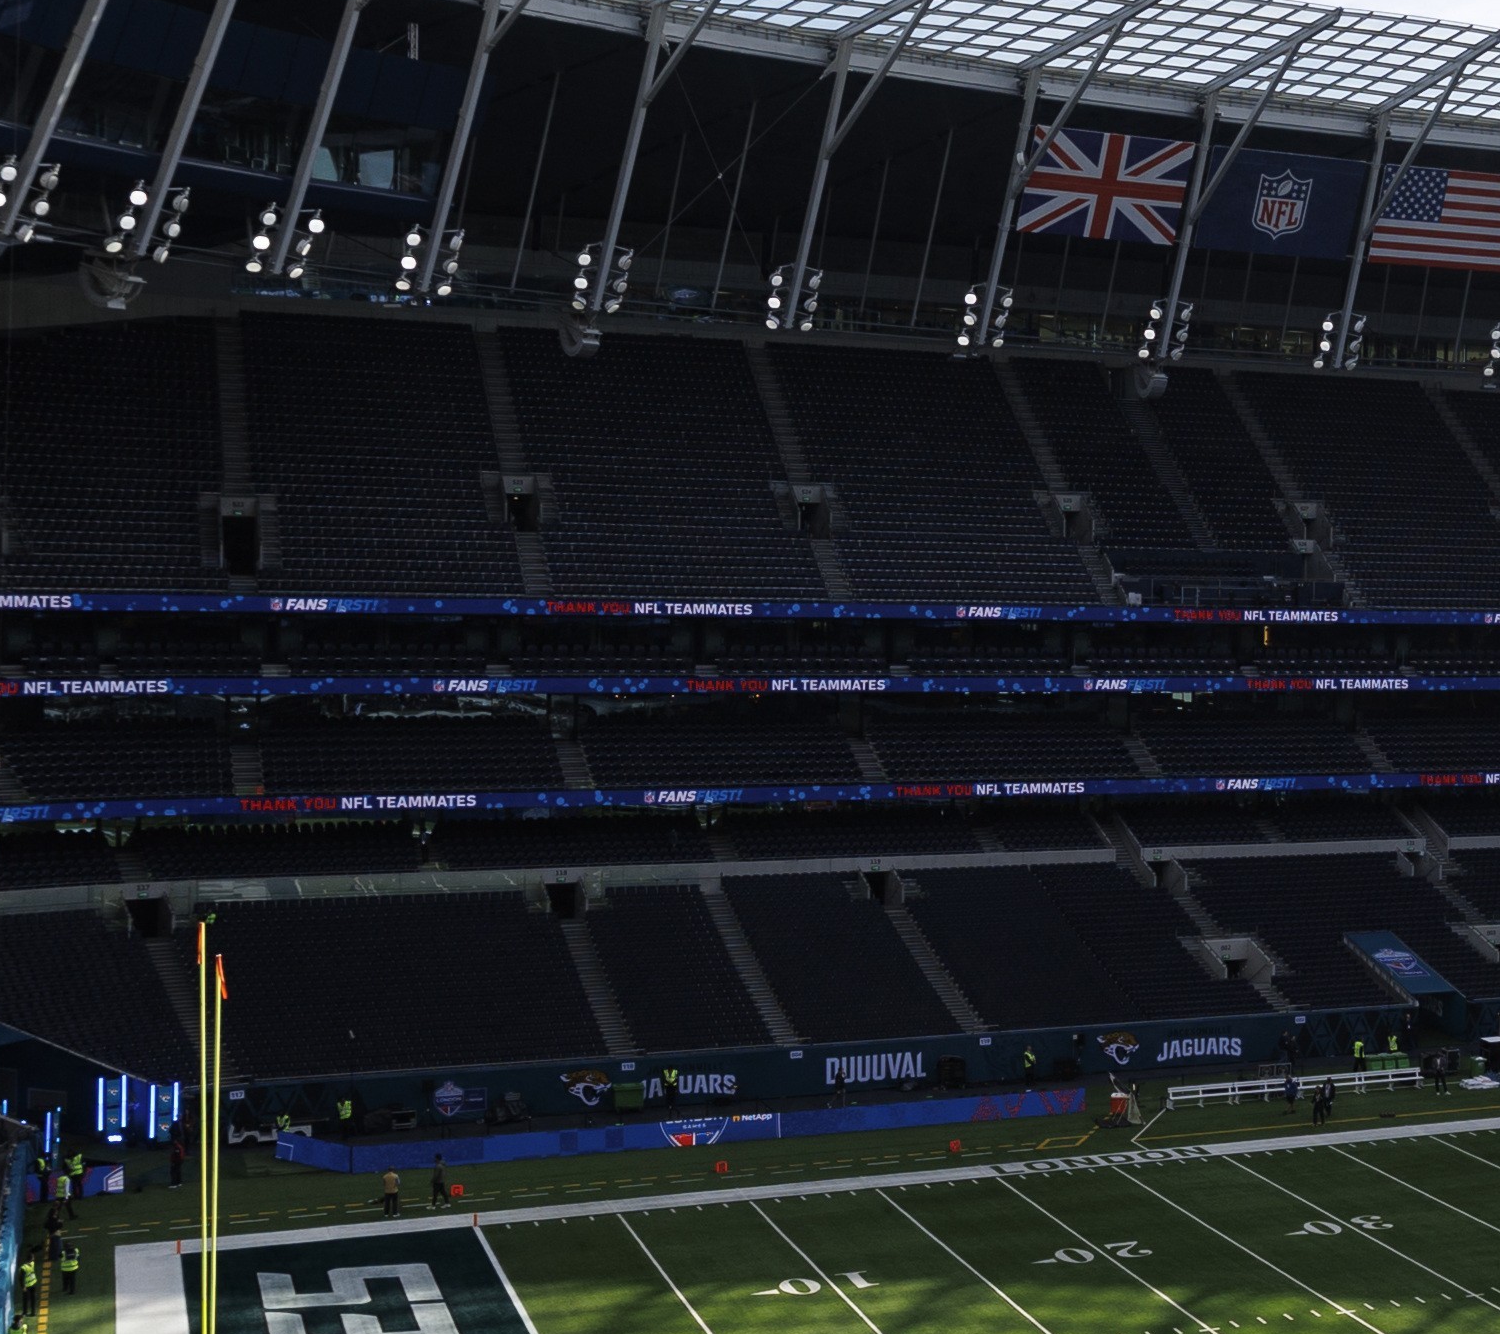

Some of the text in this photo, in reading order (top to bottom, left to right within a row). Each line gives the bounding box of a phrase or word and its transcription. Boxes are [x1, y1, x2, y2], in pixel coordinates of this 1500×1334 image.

[1258, 197, 1300, 230] NFL
[635, 602, 661, 615] NFL
[665, 602, 753, 616] TEAMMATES
[1268, 610, 1339, 622] TEAMMATES
[24, 681, 56, 694] NFL
[60, 680, 168, 694] TEAMMATES
[772, 679, 798, 692] NFL
[801, 679, 886, 691] TEAMMATES
[1340, 678, 1409, 690] TEAMMATES
[976, 784, 1001, 796] NFL
[1005, 781, 1085, 795] TEAMMATES
[341, 796, 373, 809] NFL
[376, 794, 477, 809] TEAMMATES
[1156, 1037, 1242, 1062] JAGUARS
[825, 1051, 927, 1082] DUUUVAL
[643, 1074, 739, 1099] JAUARS
[740, 1112, 773, 1123] NetApp
[991, 1146, 1211, 1175] LONDON
[1304, 1214, 1395, 1237] 30
[1051, 1240, 1153, 1266] 20
[776, 1270, 881, 1297] 10
